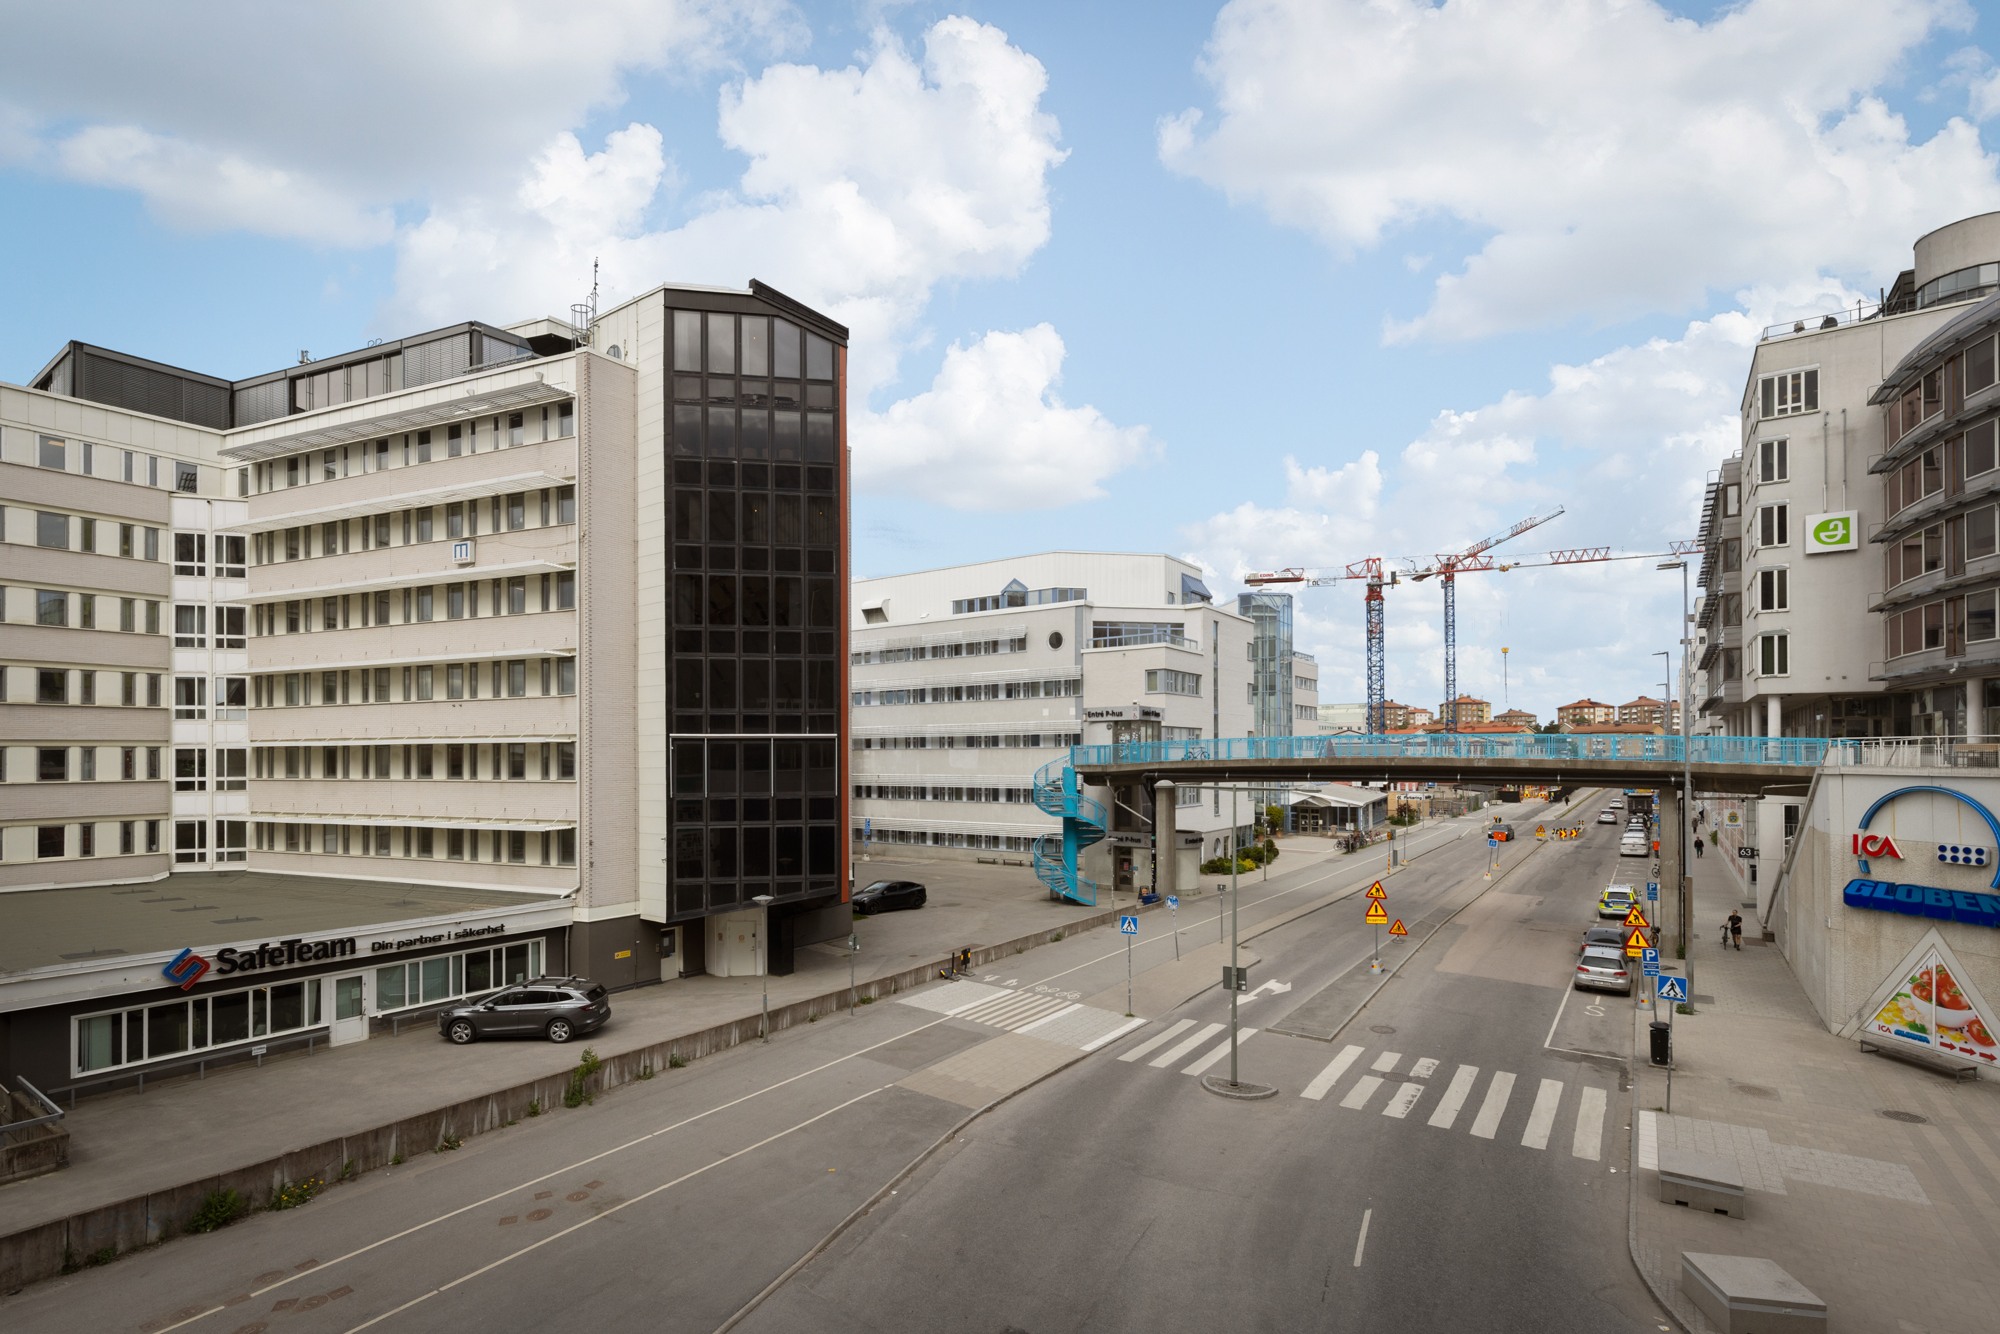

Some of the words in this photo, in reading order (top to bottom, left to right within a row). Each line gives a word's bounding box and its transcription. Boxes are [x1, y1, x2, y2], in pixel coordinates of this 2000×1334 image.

[1087, 710, 1104, 718] Entré
[1105, 709, 1123, 717] P-hus
[1740, 848, 1751, 856] 63
[1852, 834, 1903, 860] ICA
[216, 936, 357, 975] SafeTeam
[371, 940, 393, 953] Din
[396, 933, 445, 950] partner
[447, 930, 451, 940] i
[454, 923, 505, 940] säkerhet
[1646, 949, 1656, 961] P
[1877, 1023, 1892, 1035] ICA
